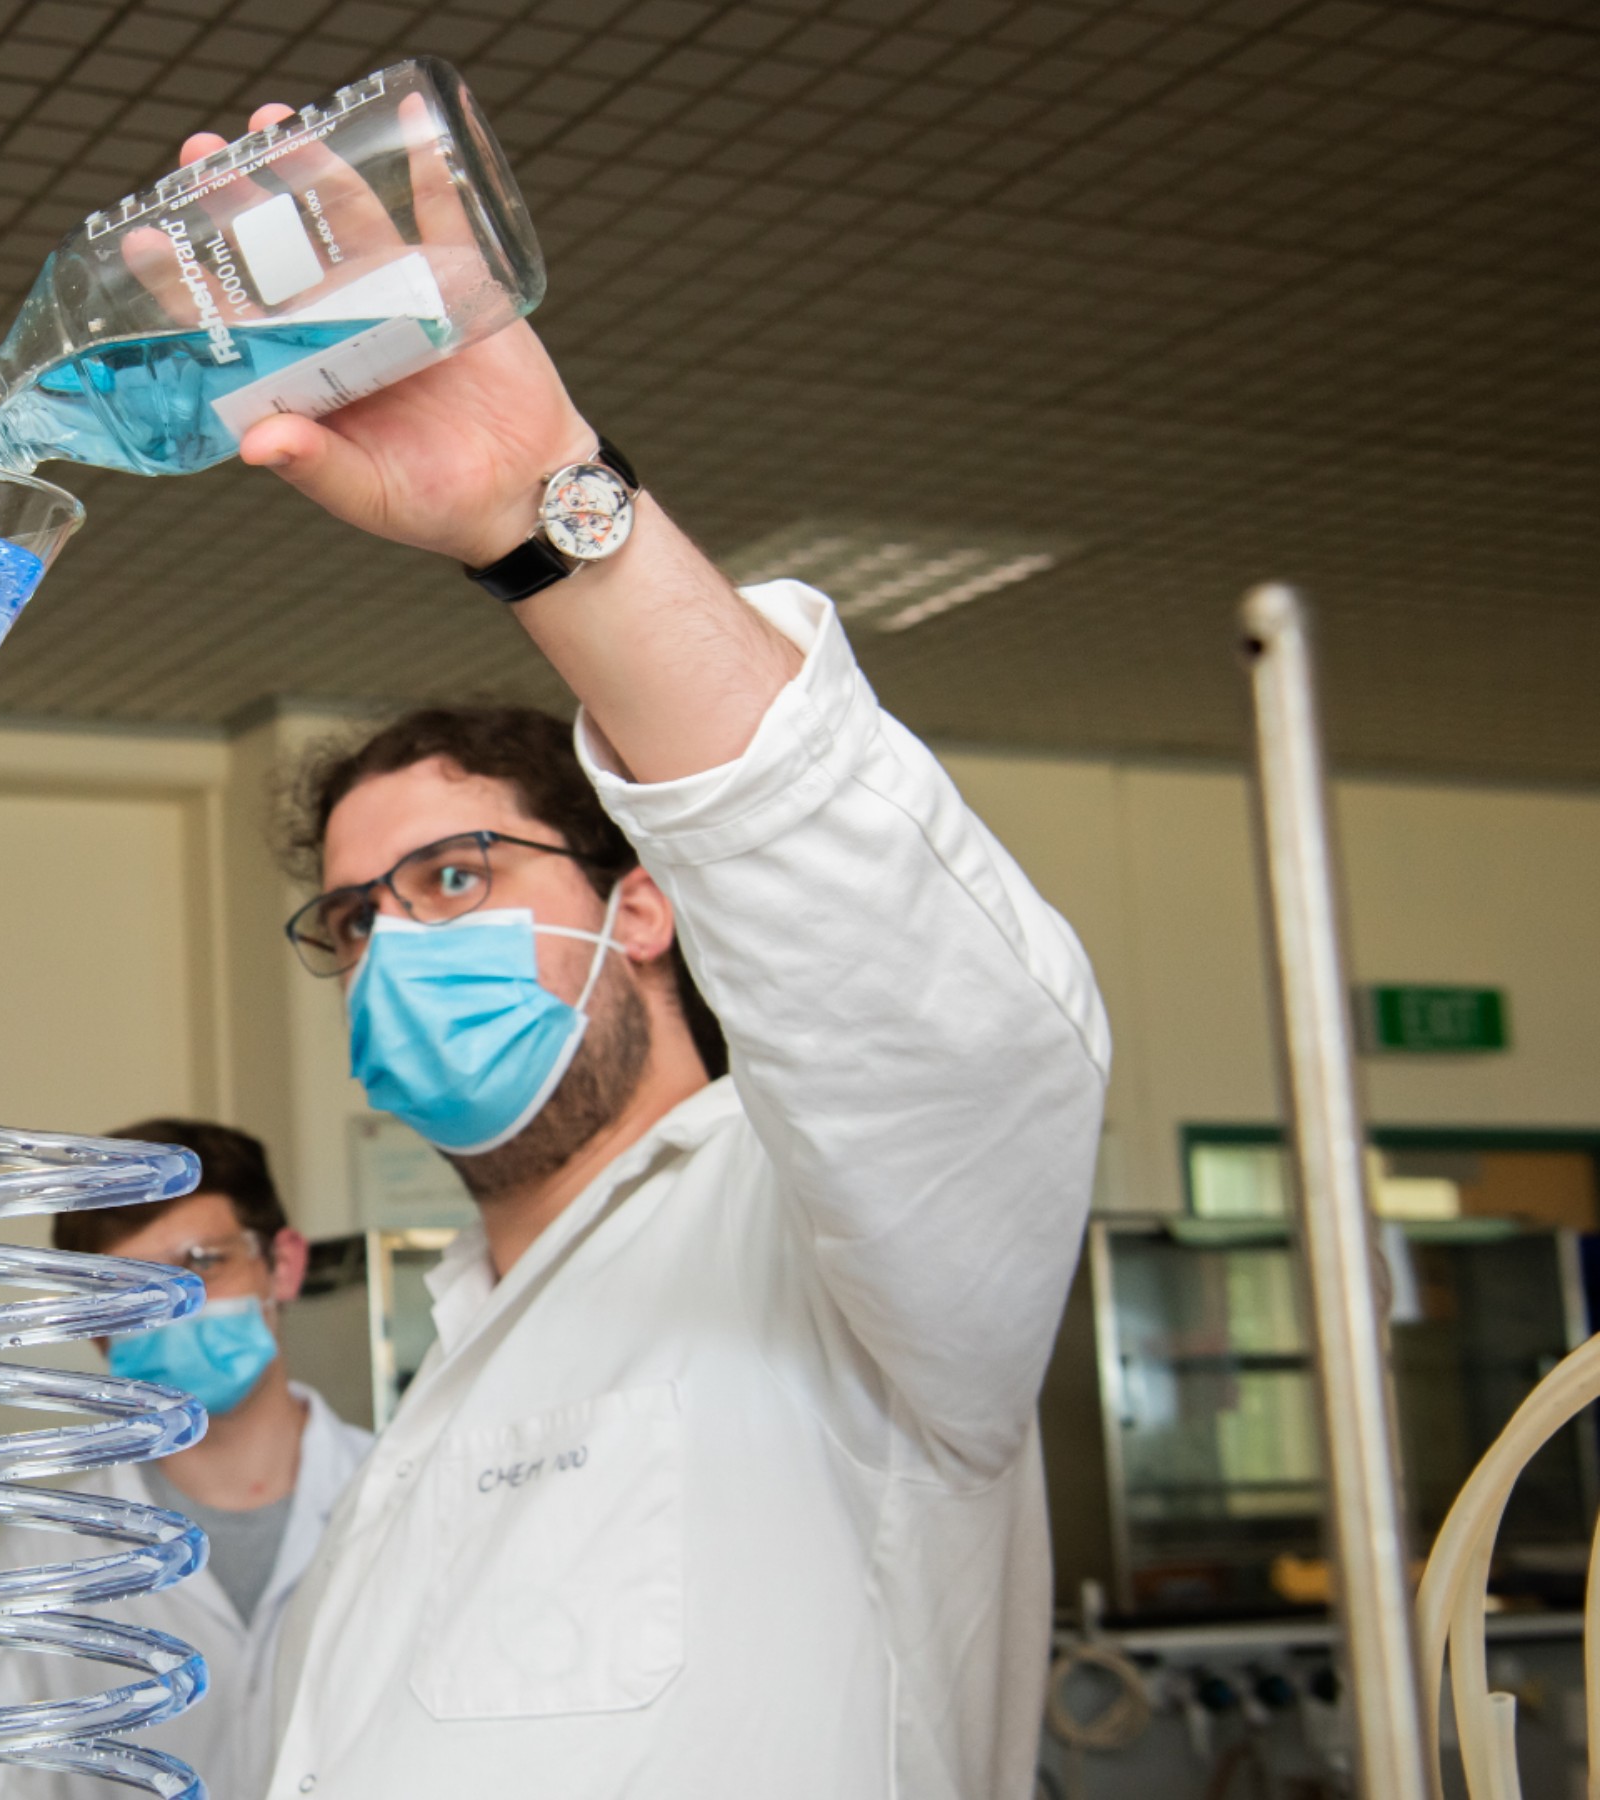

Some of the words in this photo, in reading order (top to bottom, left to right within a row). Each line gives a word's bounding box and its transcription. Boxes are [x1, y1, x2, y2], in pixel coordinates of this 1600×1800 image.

[240, 121, 337, 176] APPROXIMATE
[170, 173, 236, 211] VOLUMES
[161, 219, 243, 365] Fisherbrand
